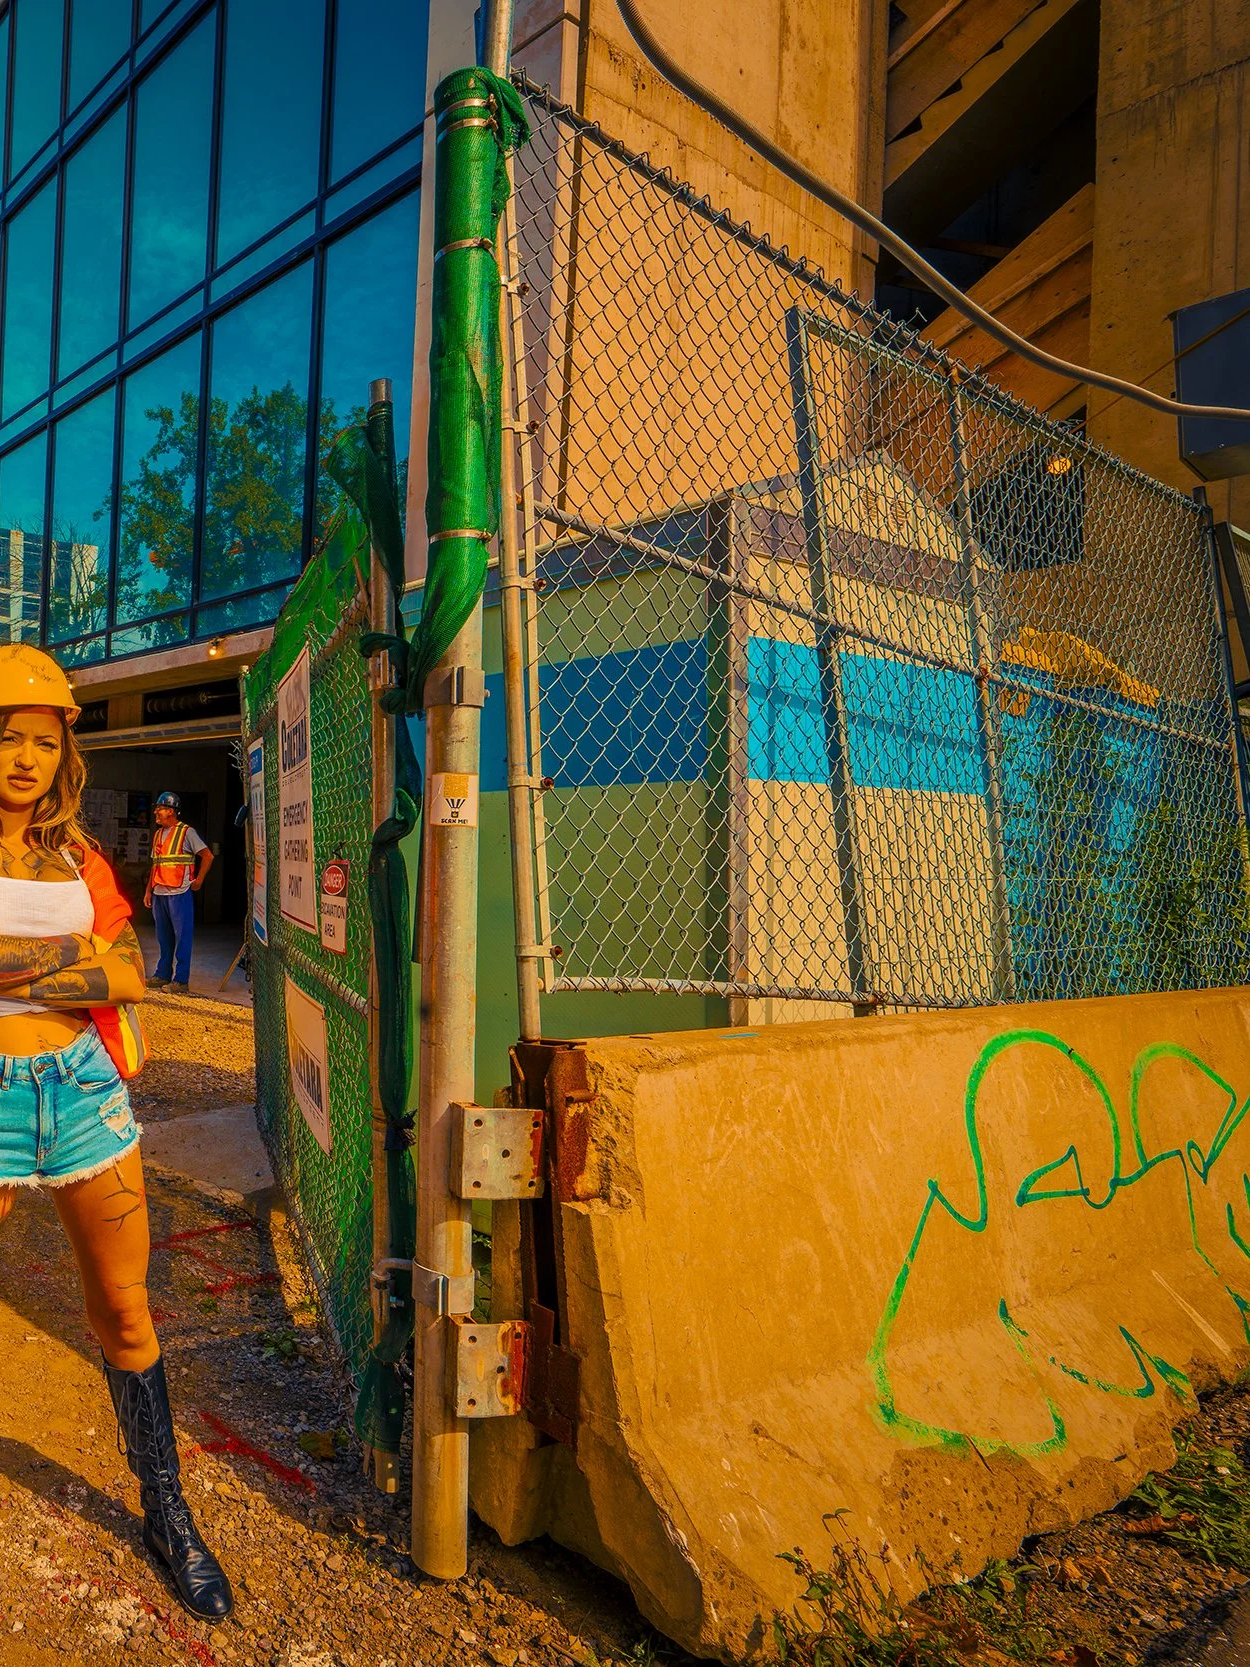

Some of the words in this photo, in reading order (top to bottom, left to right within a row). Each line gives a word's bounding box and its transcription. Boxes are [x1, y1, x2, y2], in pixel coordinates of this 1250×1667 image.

[283, 800, 309, 828] EMERGENCY
[283, 839, 309, 863] GATHERING
[288, 874, 302, 899] POINT
[323, 873, 343, 889] DANGER
[324, 923, 335, 938] AREA
